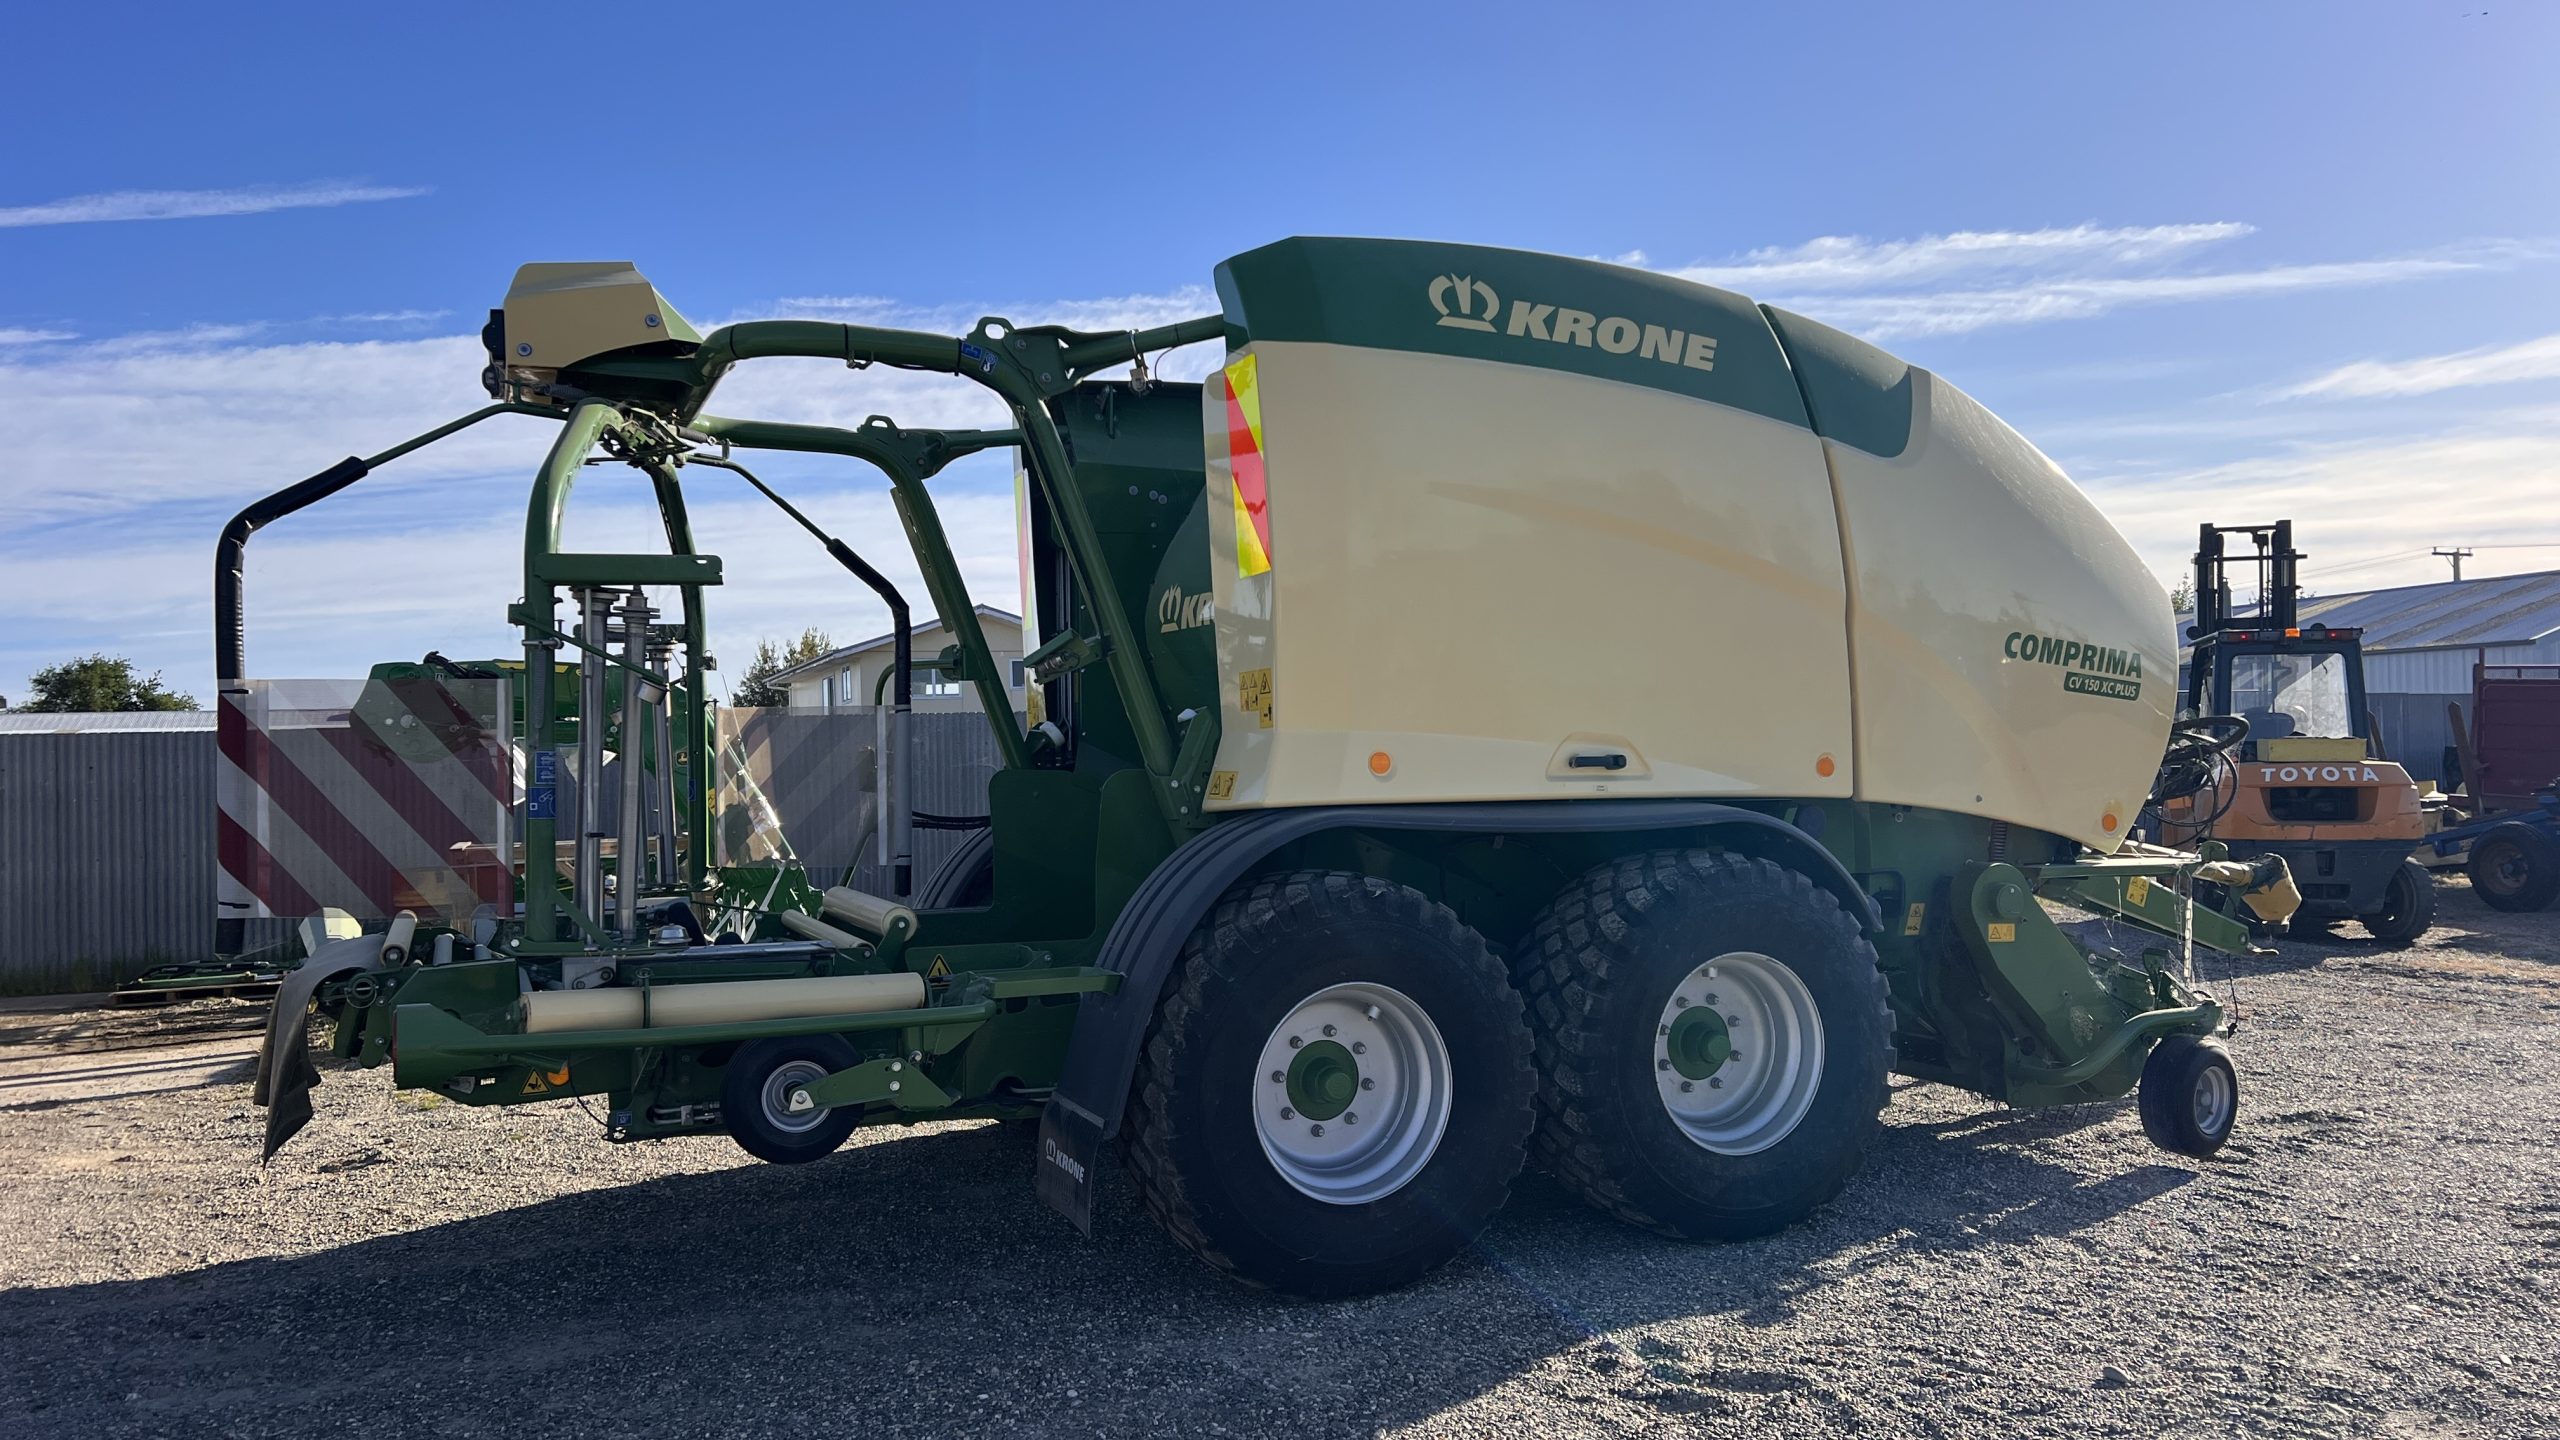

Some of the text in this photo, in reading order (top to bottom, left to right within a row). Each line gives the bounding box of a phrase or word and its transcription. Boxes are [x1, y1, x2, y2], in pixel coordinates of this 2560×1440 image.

[1507, 300, 1717, 372] KRONE
[2005, 632, 2142, 679] COMPRIMA
[2069, 676, 2137, 698] CV 150 XC PLUS
[2260, 766, 2380, 783] TOYOTA
[1055, 1149, 1085, 1184] KRONE
